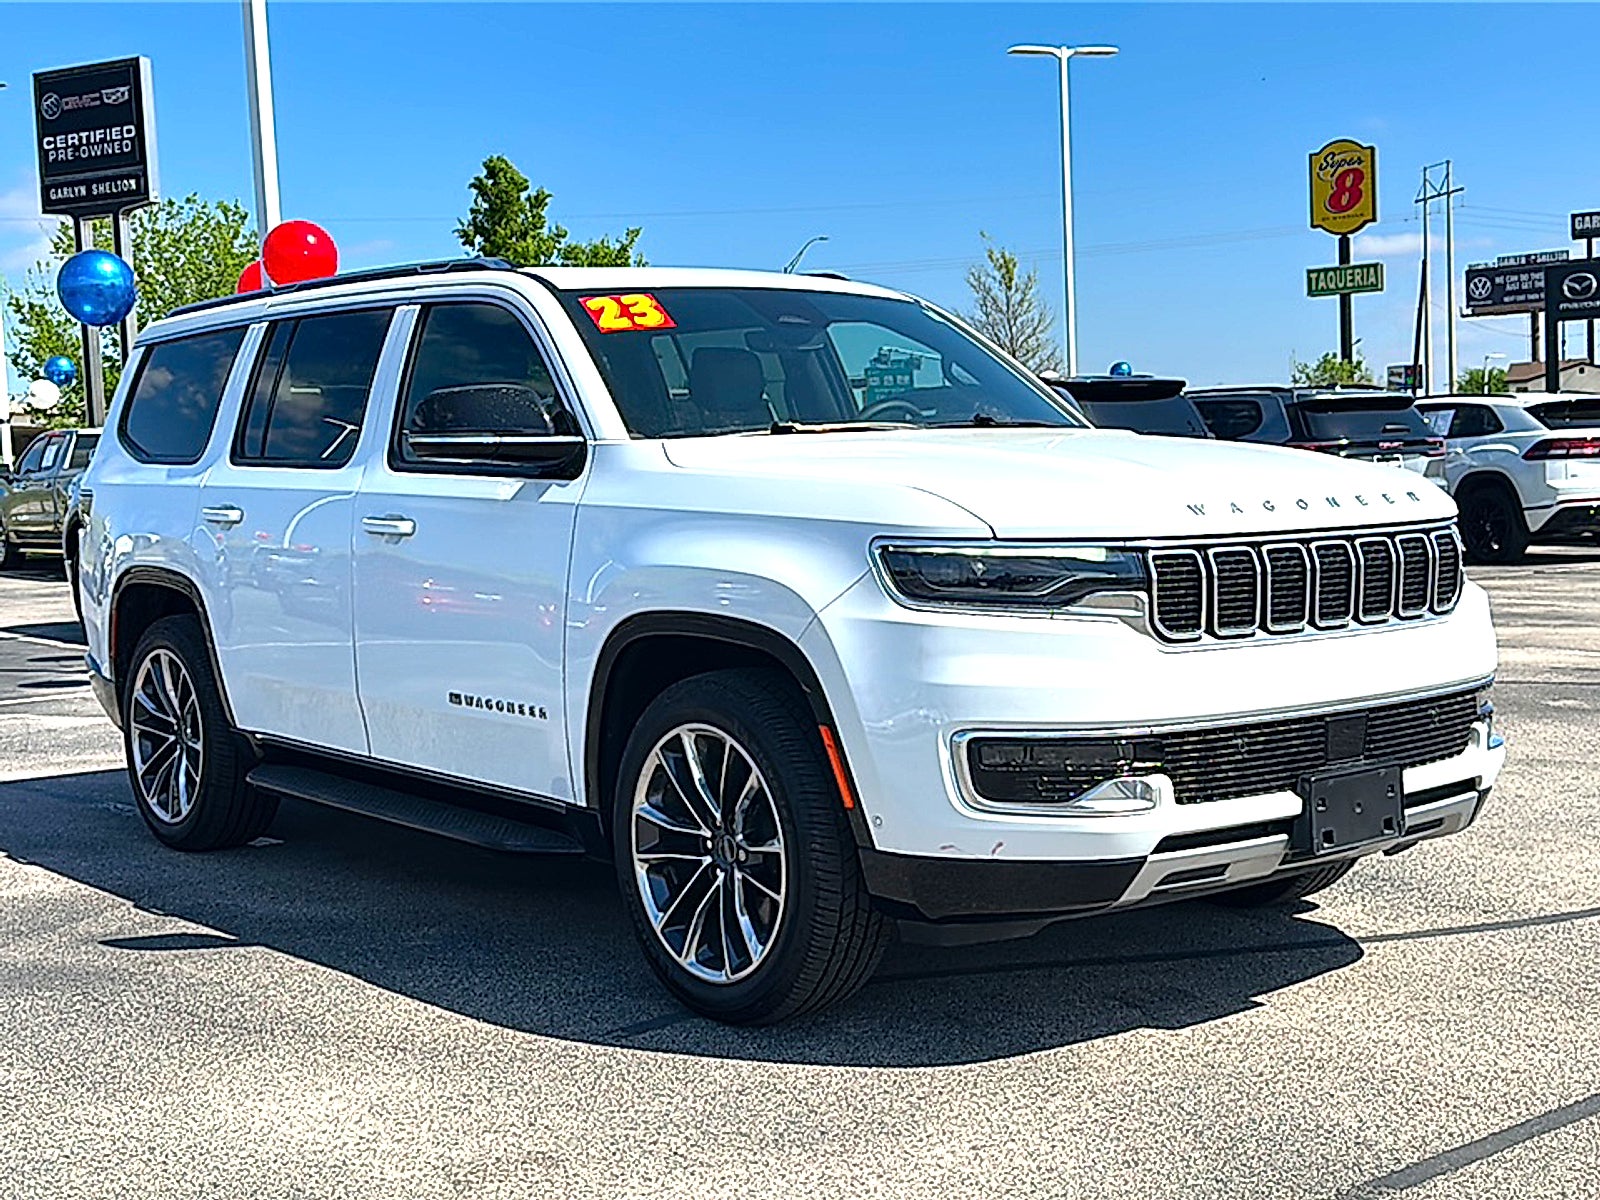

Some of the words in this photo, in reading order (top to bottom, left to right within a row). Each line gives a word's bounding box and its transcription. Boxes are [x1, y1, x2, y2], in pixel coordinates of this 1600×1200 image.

[42, 124, 136, 150] CERTIFIED
[48, 140, 132, 163] PRE-OWNED
[1318, 151, 1365, 178] Super
[49, 185, 87, 200] GARLYN
[91, 178, 137, 196] SHELTON
[1326, 167, 1365, 214] 8
[1309, 266, 1377, 291] TAQUERIA
[586, 294, 665, 329] 23
[1187, 491, 1420, 516] WAGONEER
[463, 694, 548, 720] WAGONEER
